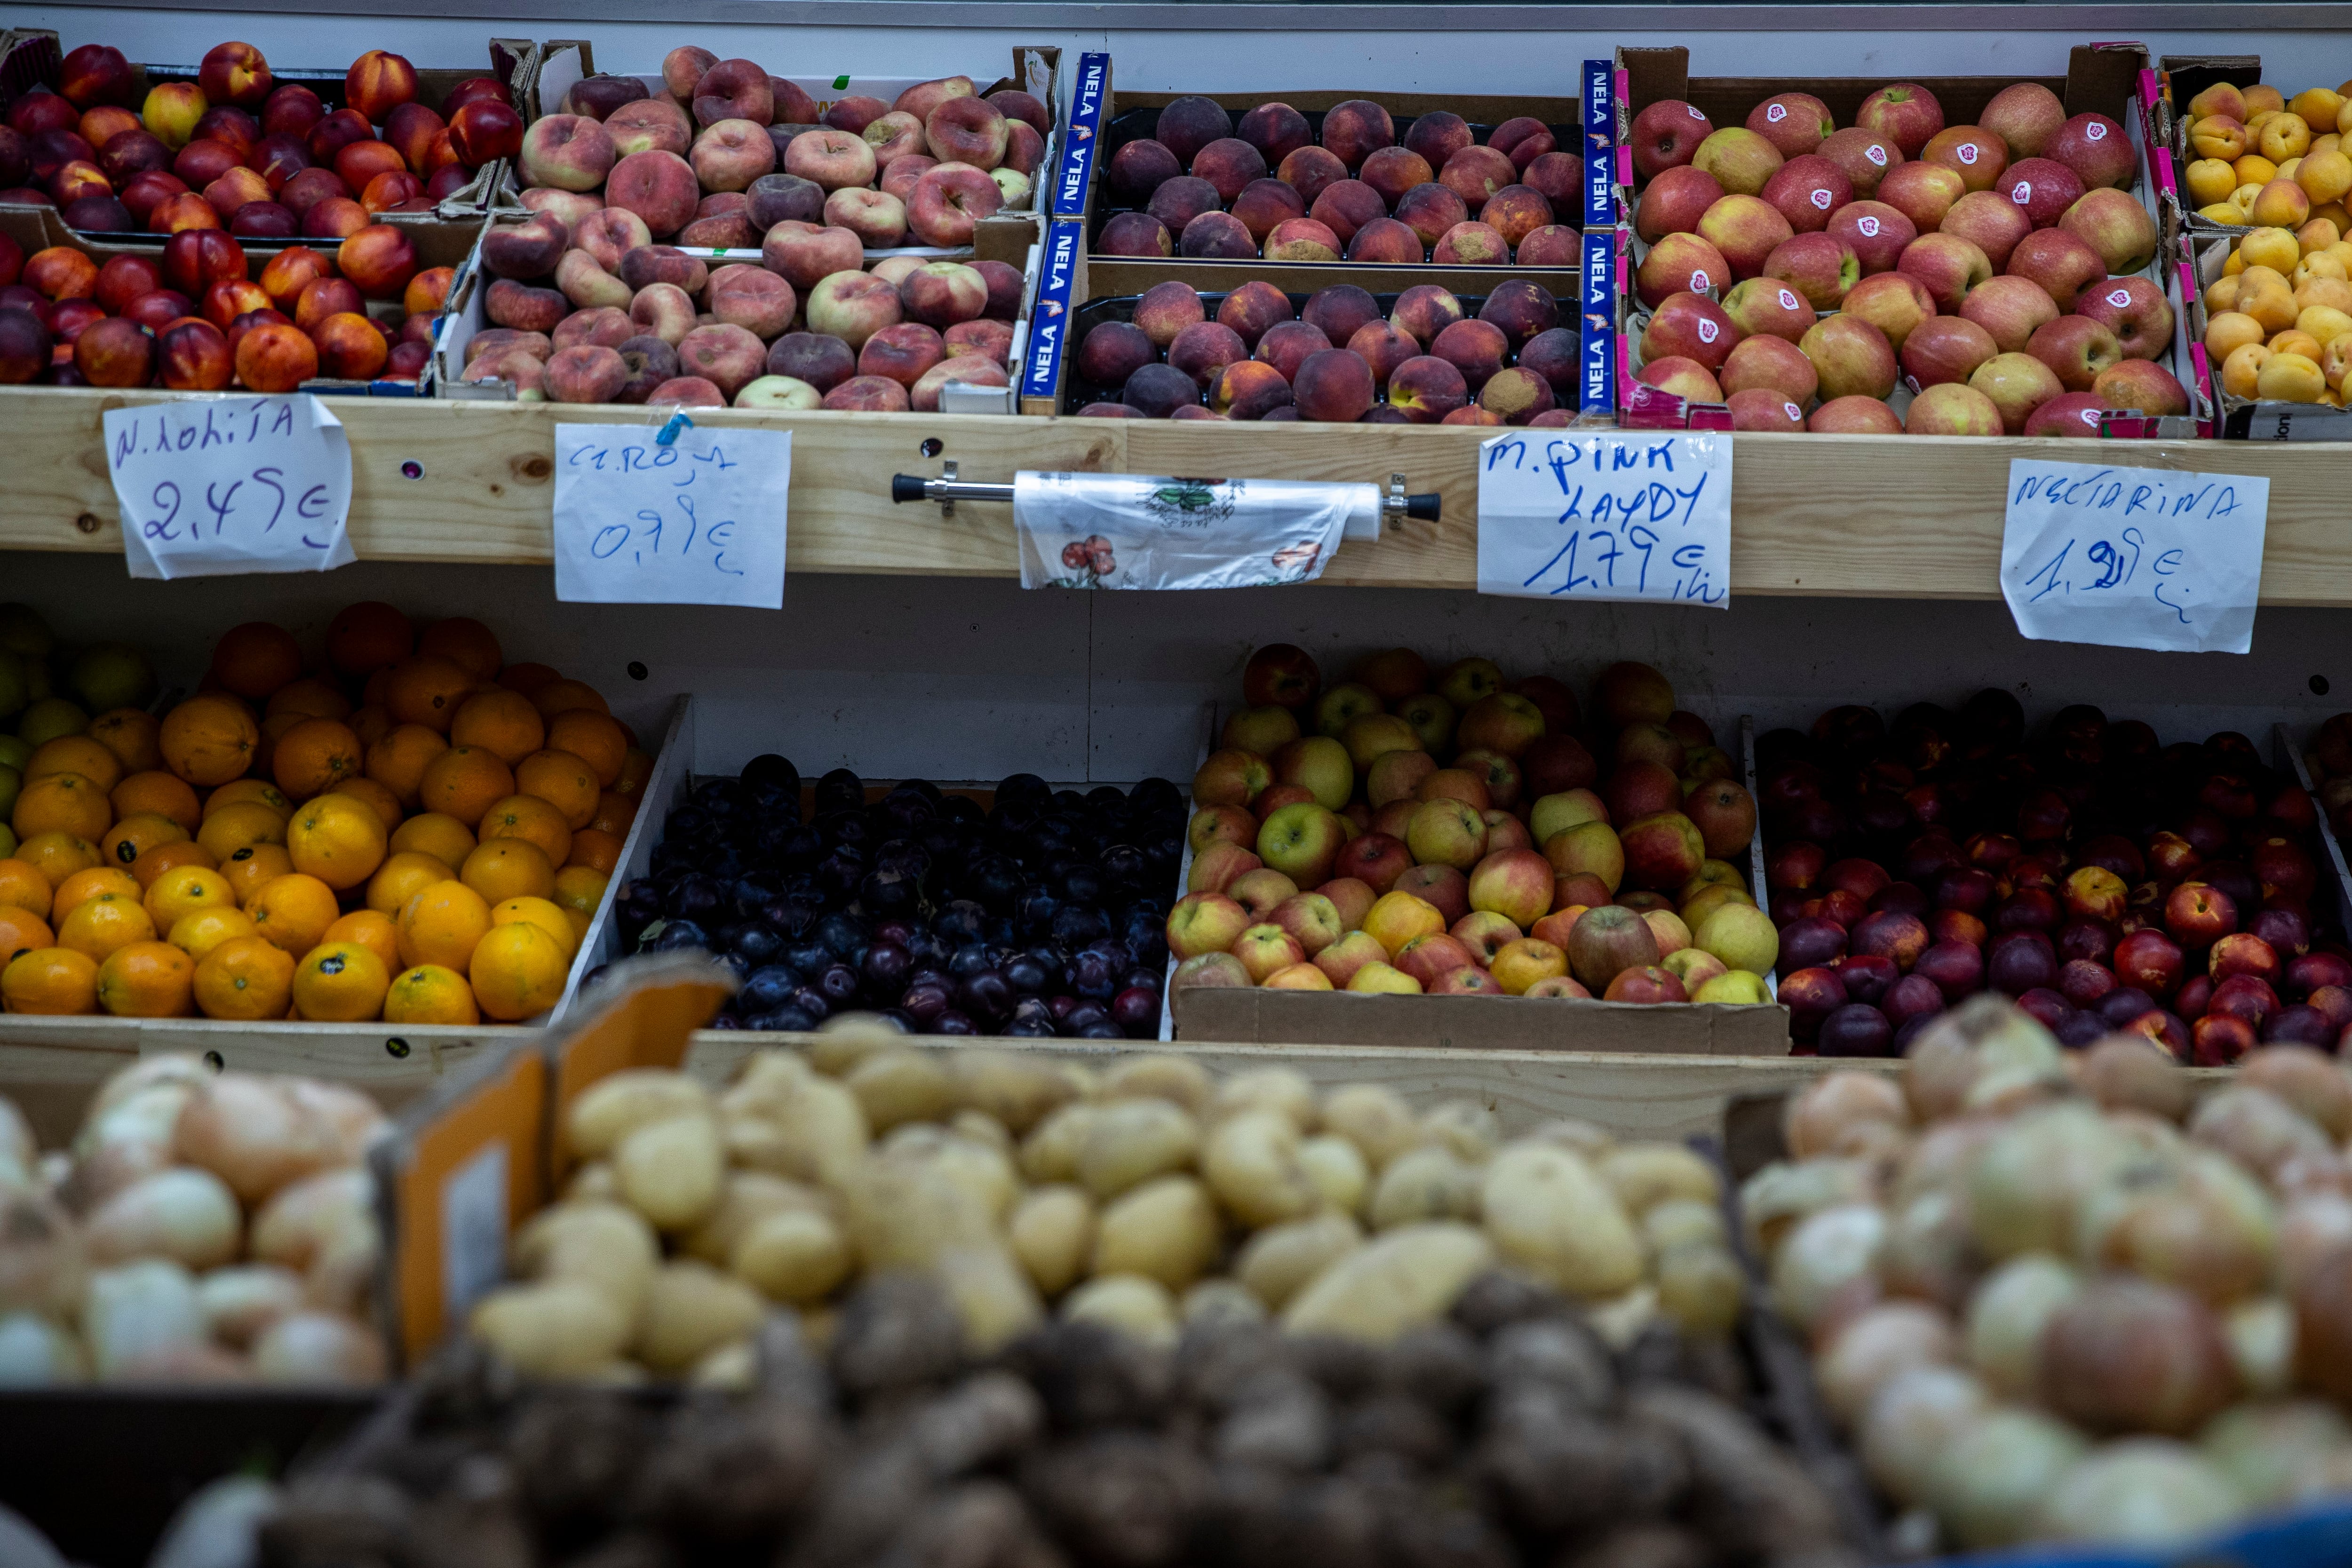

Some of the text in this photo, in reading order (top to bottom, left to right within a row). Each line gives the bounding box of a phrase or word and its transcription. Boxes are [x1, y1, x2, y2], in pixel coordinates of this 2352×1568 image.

[1080, 66, 1102, 117] NELA
[1594, 72, 1606, 124] NELA
[1063, 148, 1086, 200] NELA
[1594, 156, 1607, 211] NELA
[1050, 235, 1073, 291] NELA
[1591, 247, 1605, 304] NELA
[1033, 325, 1057, 382] NELA
[1589, 339, 1604, 398] NELA
